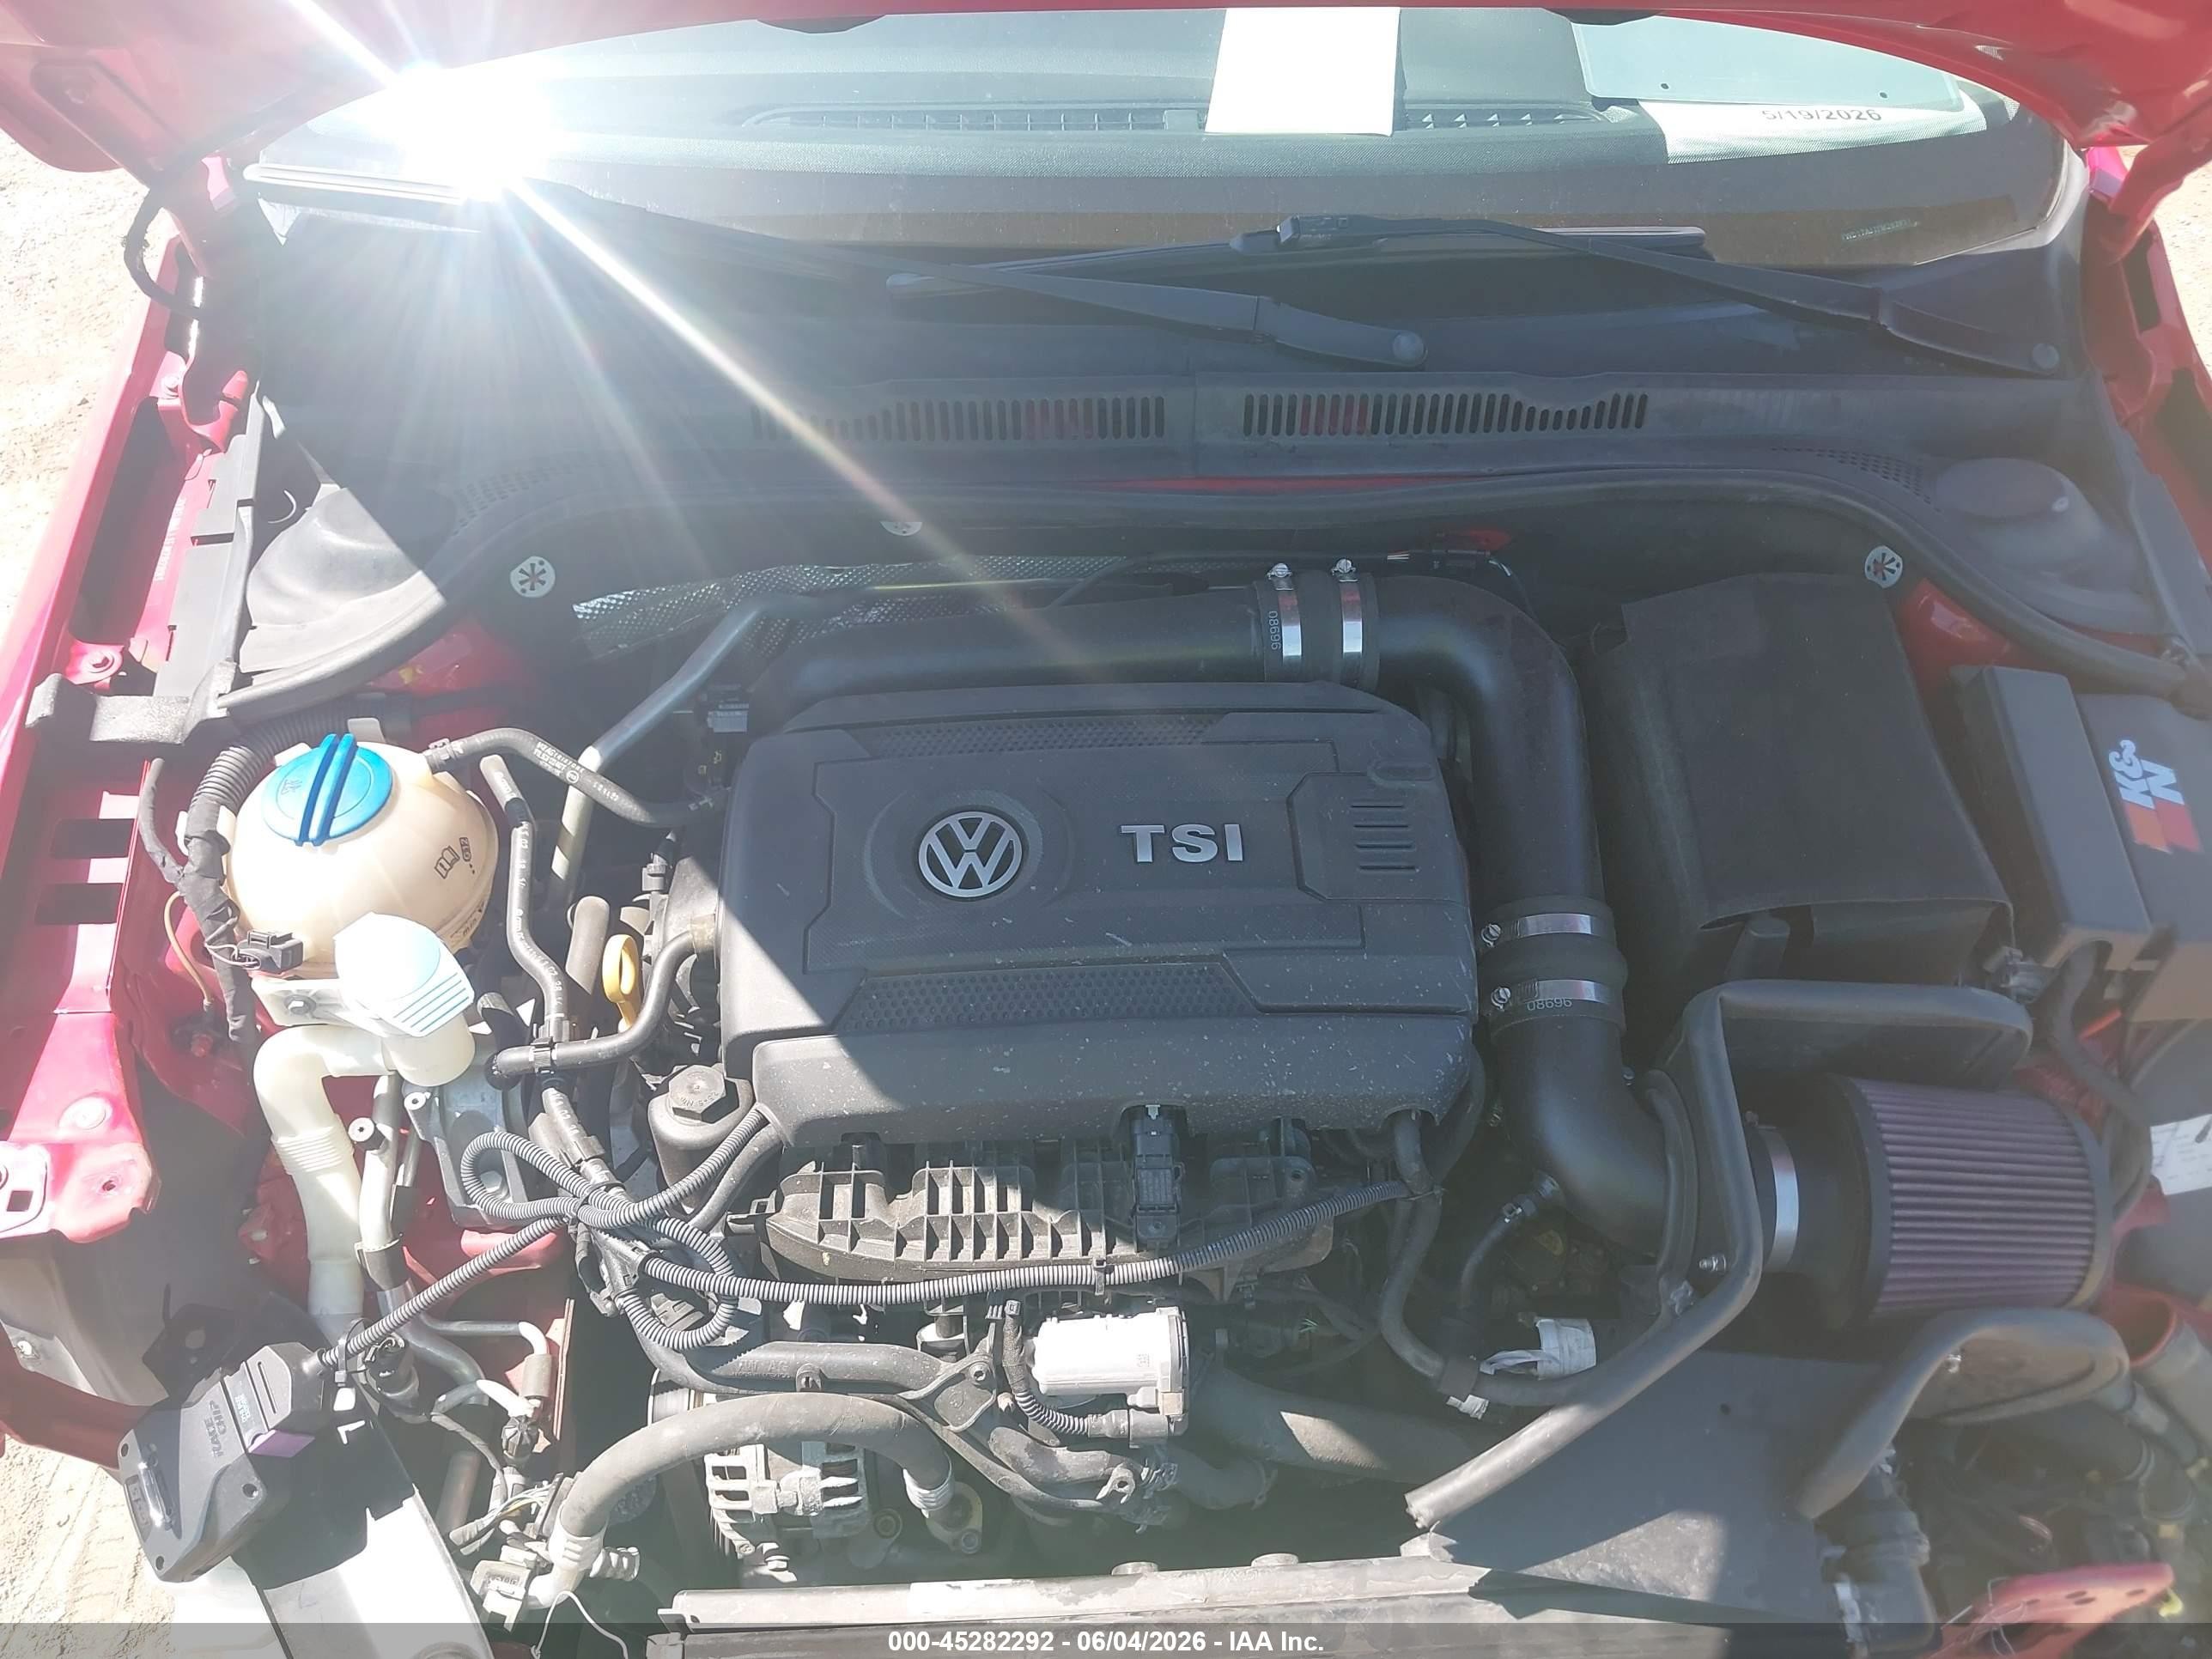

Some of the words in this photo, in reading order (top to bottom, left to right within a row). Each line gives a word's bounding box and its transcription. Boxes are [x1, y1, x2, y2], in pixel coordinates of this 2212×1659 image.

[1761, 108, 1882, 121] 5/19/2026
[2108, 739, 2185, 810] K&N
[1120, 823, 1244, 863] TSI
